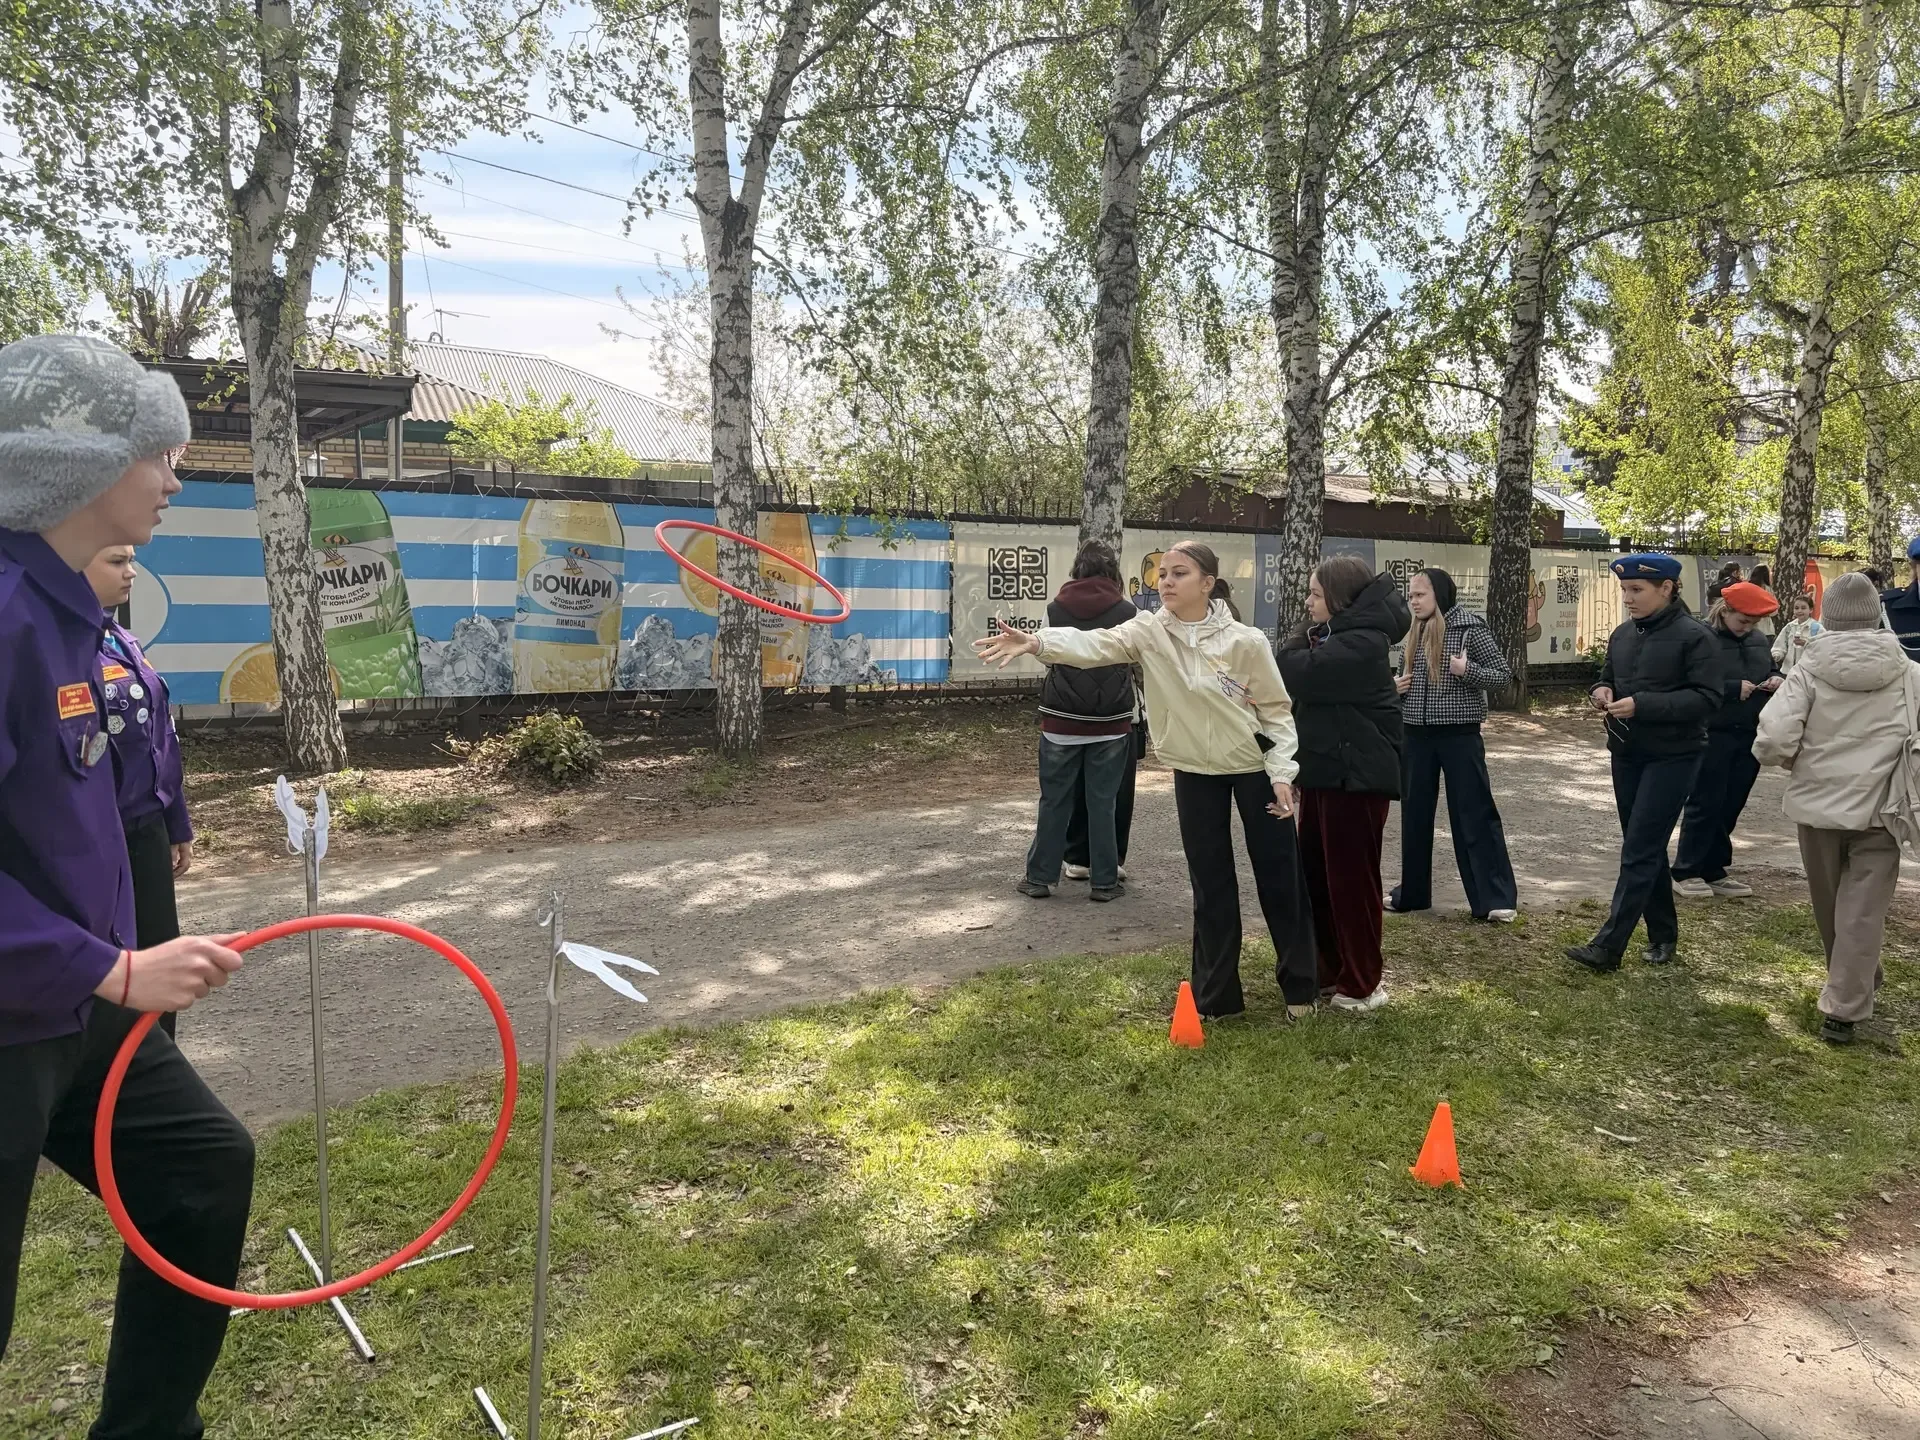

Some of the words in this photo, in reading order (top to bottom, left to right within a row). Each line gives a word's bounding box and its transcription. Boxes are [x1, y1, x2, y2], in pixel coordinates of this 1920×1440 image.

[532, 573, 612, 599] БОЧКАРИ
[553, 595, 574, 605] ЧТОБЫ
[335, 612, 363, 625] ТАРХУН
[556, 618, 586, 628] ЛИМОНАД
